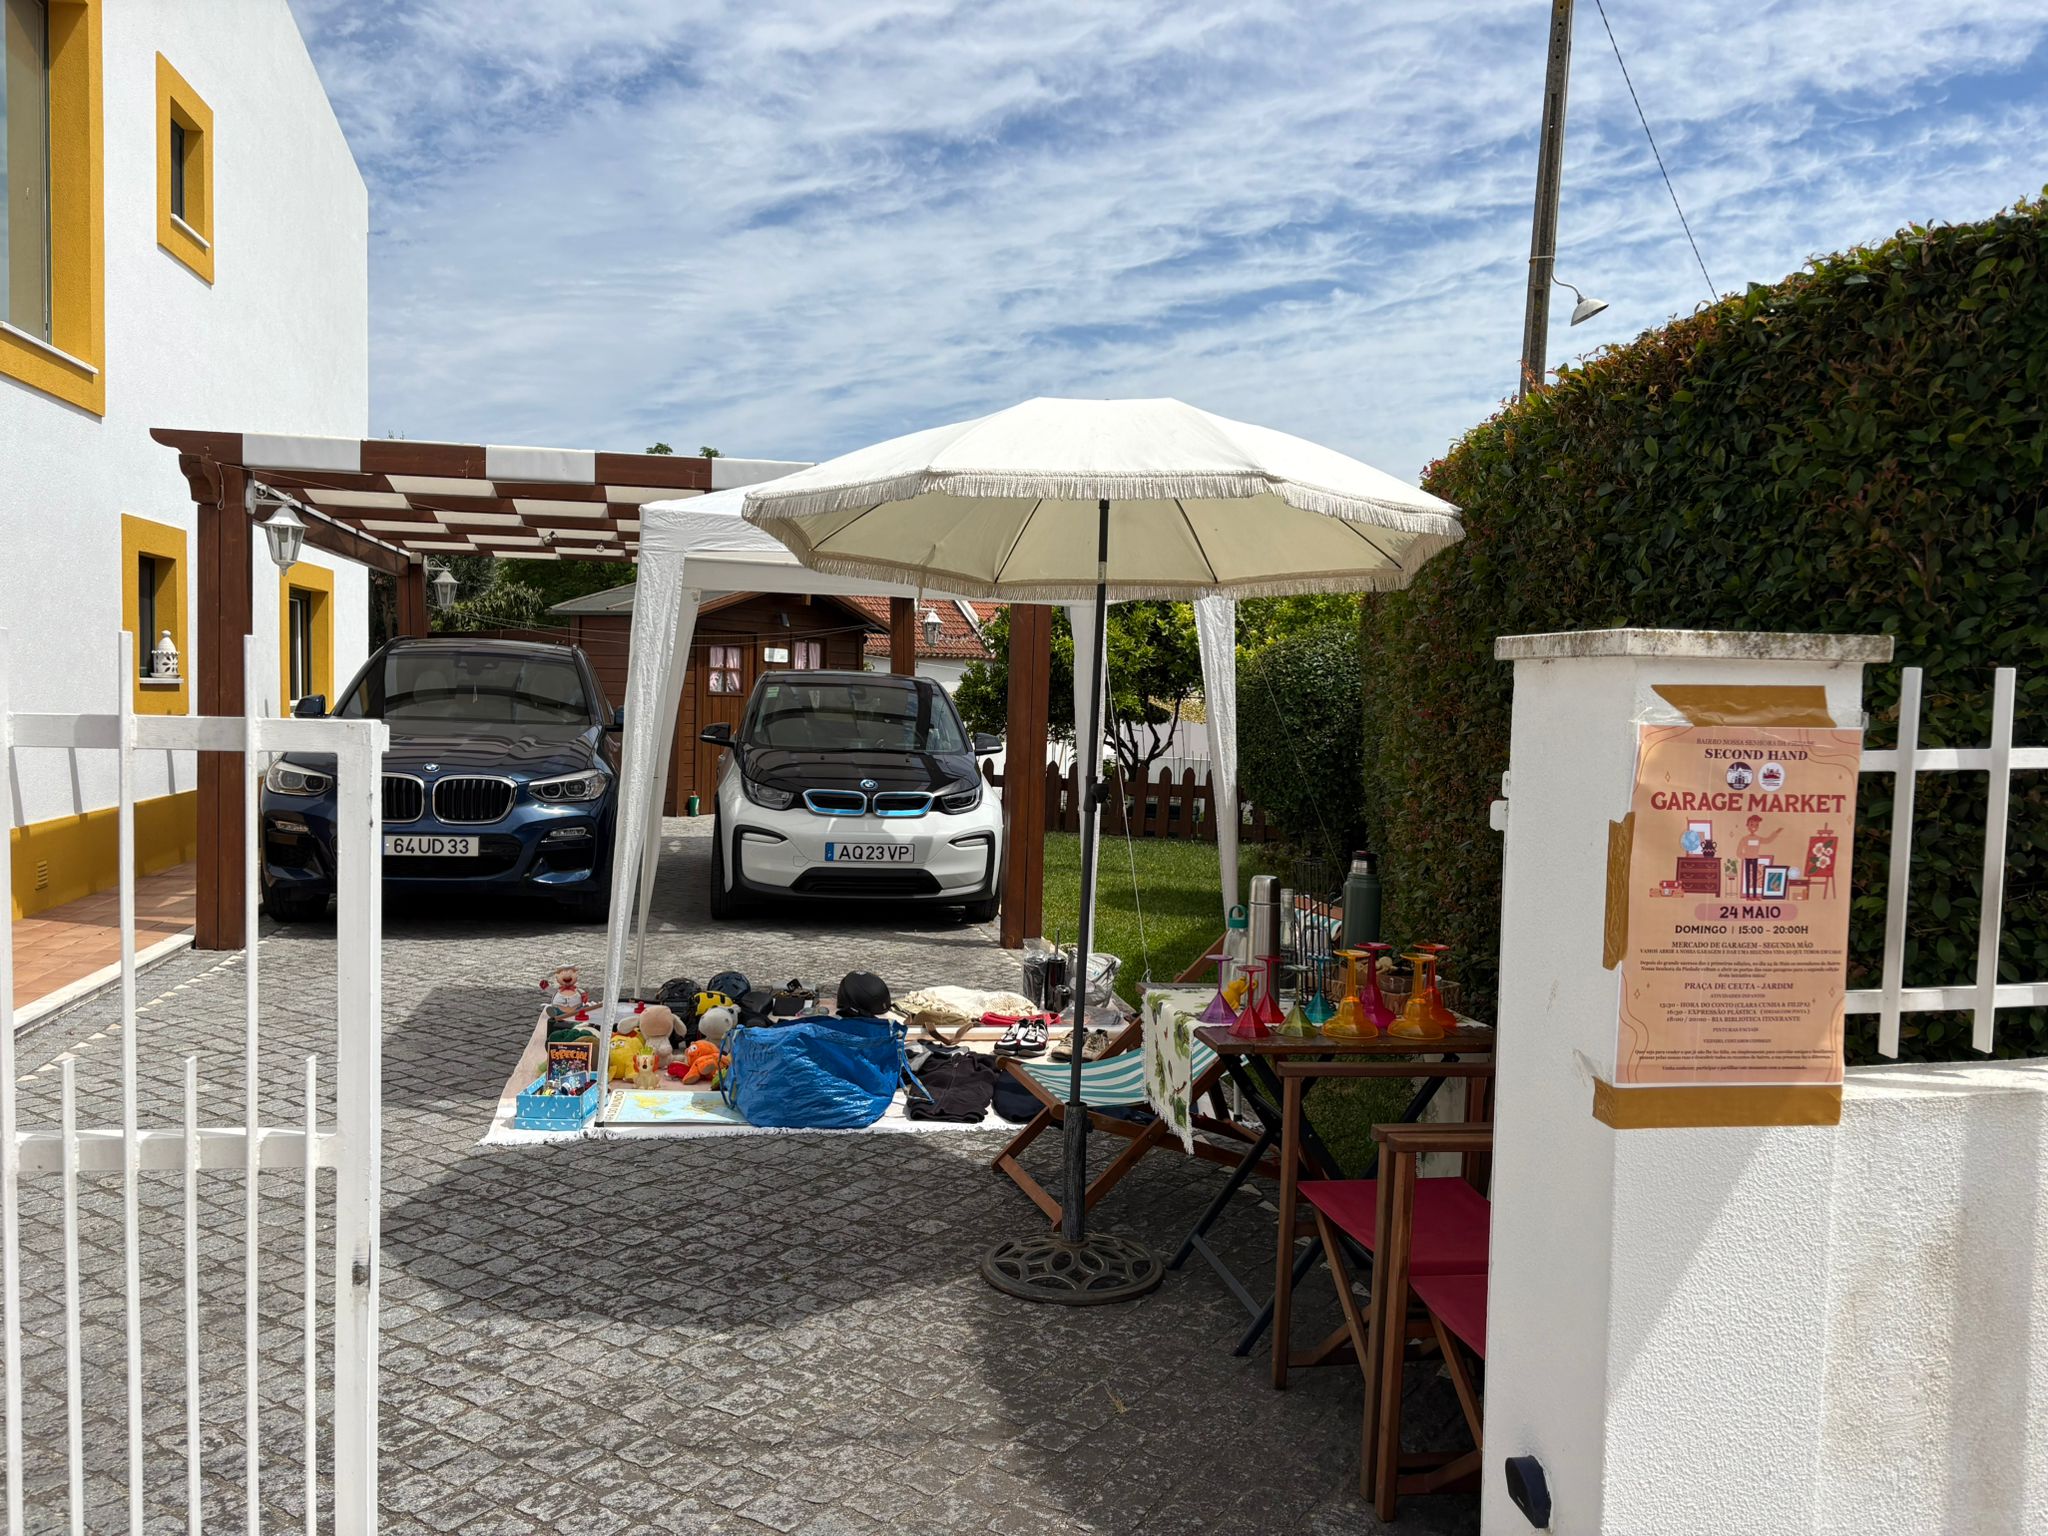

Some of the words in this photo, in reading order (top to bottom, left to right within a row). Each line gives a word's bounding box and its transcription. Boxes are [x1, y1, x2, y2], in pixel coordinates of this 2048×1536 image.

[1704, 748, 1763, 760] SECOND
[1767, 750, 1807, 760] HAND
[1651, 792, 1743, 811] GARAGE
[1748, 794, 1846, 813] MARKET
[1719, 906, 1738, 919] 24
[1742, 906, 1781, 919] MAIO
[1675, 925, 1727, 934] DOMINGO
[1738, 926, 1763, 934] 15:00
[1773, 926, 1809, 934] 20:00H
[1684, 982, 1712, 991] PRAÇA
